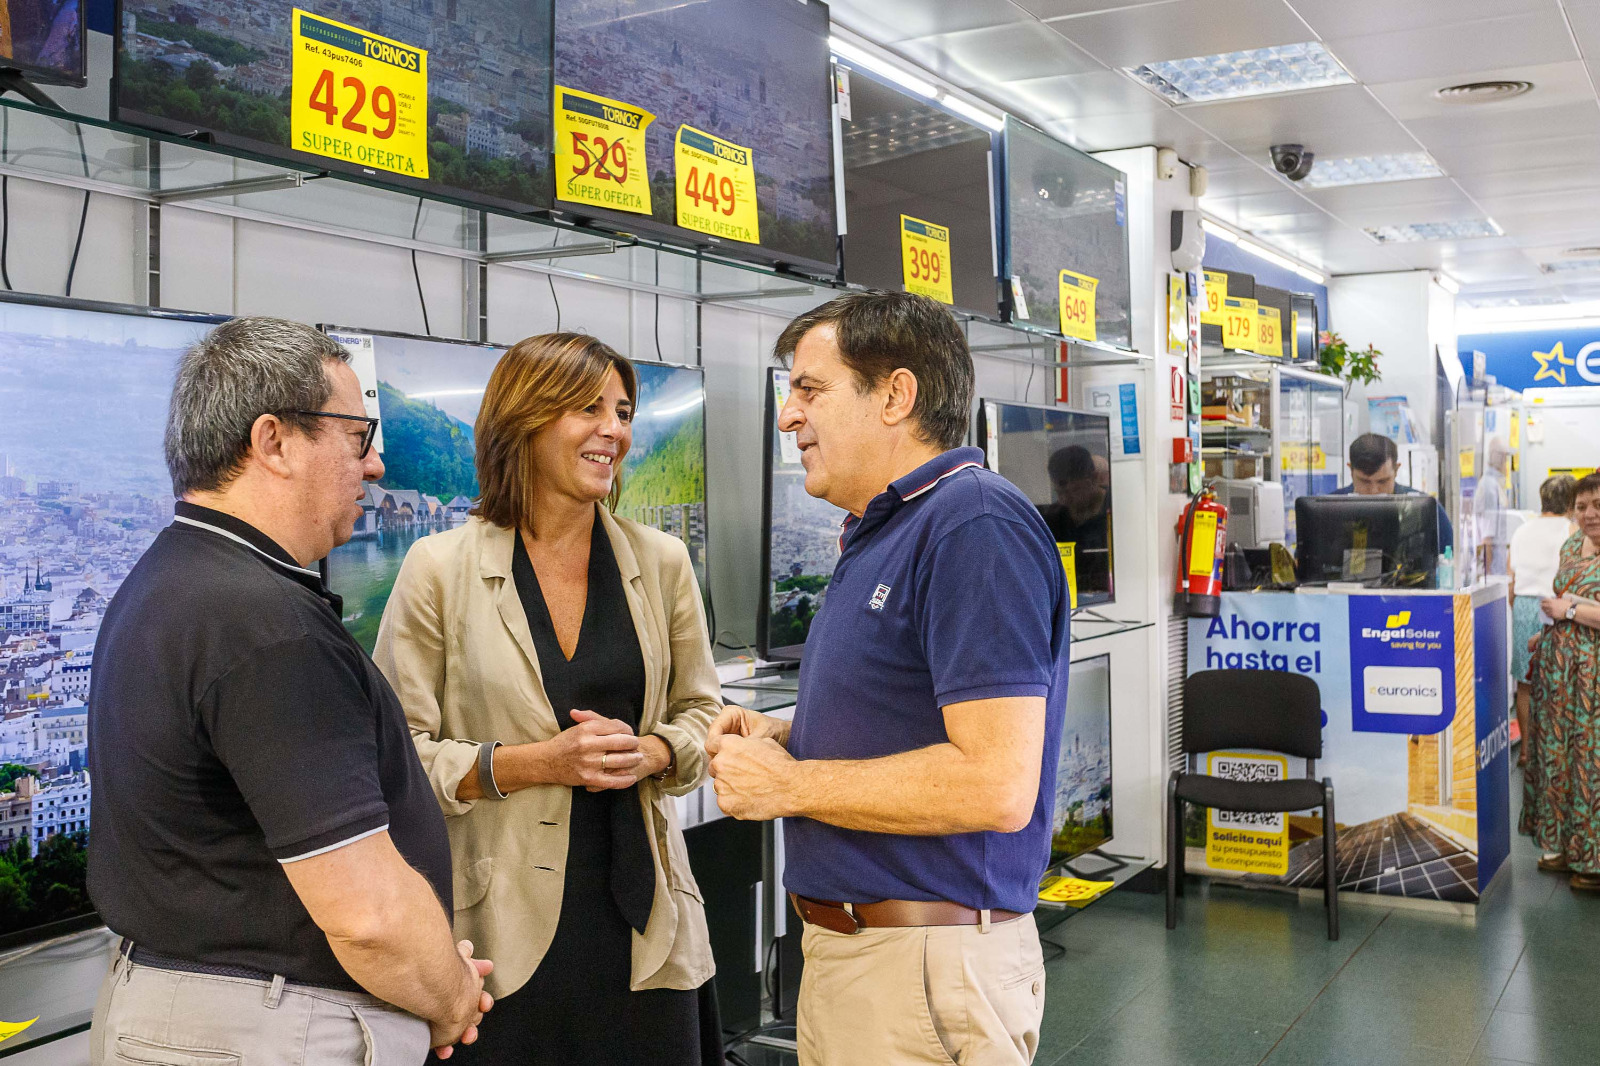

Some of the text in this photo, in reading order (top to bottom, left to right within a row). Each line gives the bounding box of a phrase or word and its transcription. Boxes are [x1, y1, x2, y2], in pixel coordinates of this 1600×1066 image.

[305, 42, 363, 67] Ref. 43pus7406
[362, 37, 417, 70] TORNOS
[309, 69, 396, 139] 429
[602, 106, 639, 127] TORNOS
[302, 131, 415, 173] SUPER OFERTA
[572, 132, 627, 184] 529
[713, 141, 745, 164] TORNOS
[567, 183, 642, 208] SUPER OFERTA
[685, 166, 735, 216] 449
[681, 212, 751, 240] SUPER OFERTA
[909, 246, 941, 284] 399
[1065, 295, 1087, 324] 649
[1228, 315, 1250, 338] 179
[1206, 614, 1321, 642] Ahorra
[1390, 641, 1441, 651] saving for you
[1206, 646, 1321, 673] hasta el
[1377, 684, 1437, 697] euronics
[1212, 844, 1282, 858] tu presupuesto
[1213, 832, 1282, 848] Solicita aquí
[1212, 855, 1282, 869] sin compromiso
